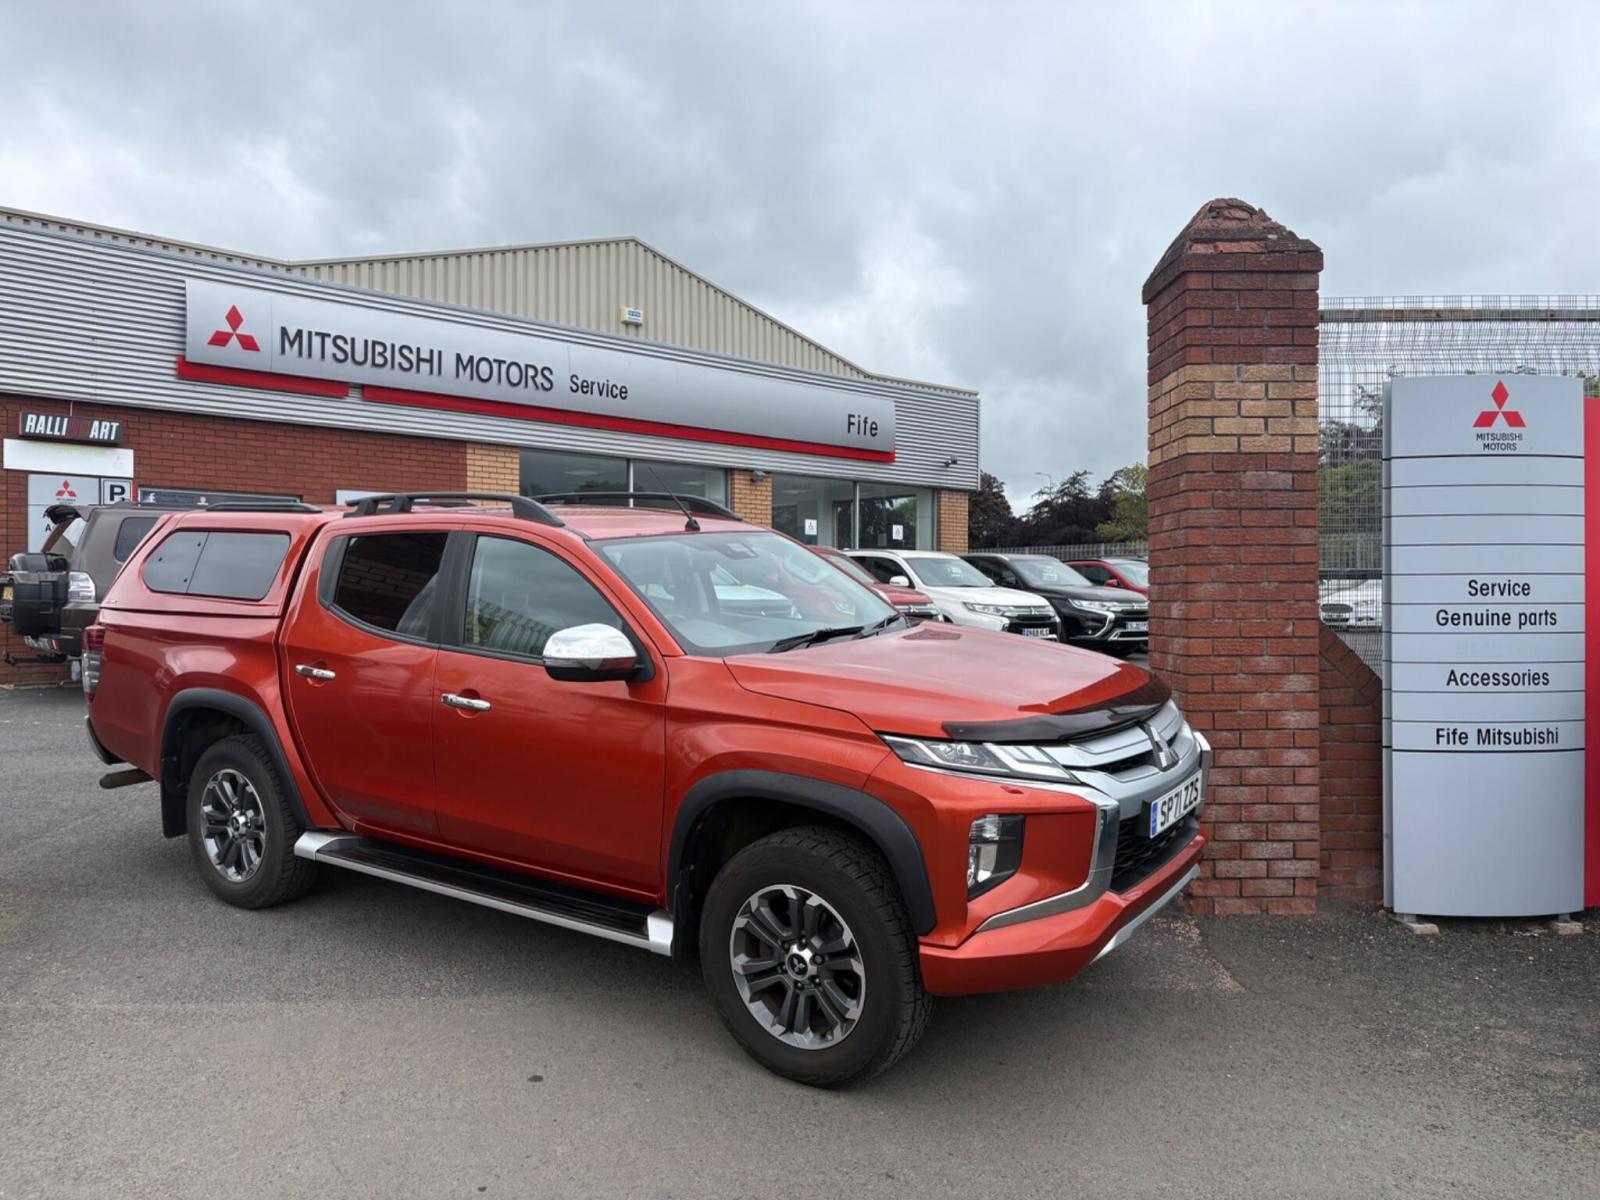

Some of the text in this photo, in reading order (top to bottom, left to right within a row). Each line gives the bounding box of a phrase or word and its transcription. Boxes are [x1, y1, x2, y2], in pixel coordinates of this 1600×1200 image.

[280, 325, 629, 400] MITSUBISHI MOTORS Service
[847, 413, 879, 437] Fife
[1476, 432, 1523, 441] MITSUBISHI
[1482, 442, 1518, 451] MOTORS
[109, 484, 126, 502] P
[1468, 579, 1531, 597] Service
[1436, 608, 1558, 630] Genuine parts
[1446, 669, 1550, 686] Accessories
[1435, 727, 1559, 745] Fife Mitsubishi
[1183, 777, 1199, 812] ZZS
